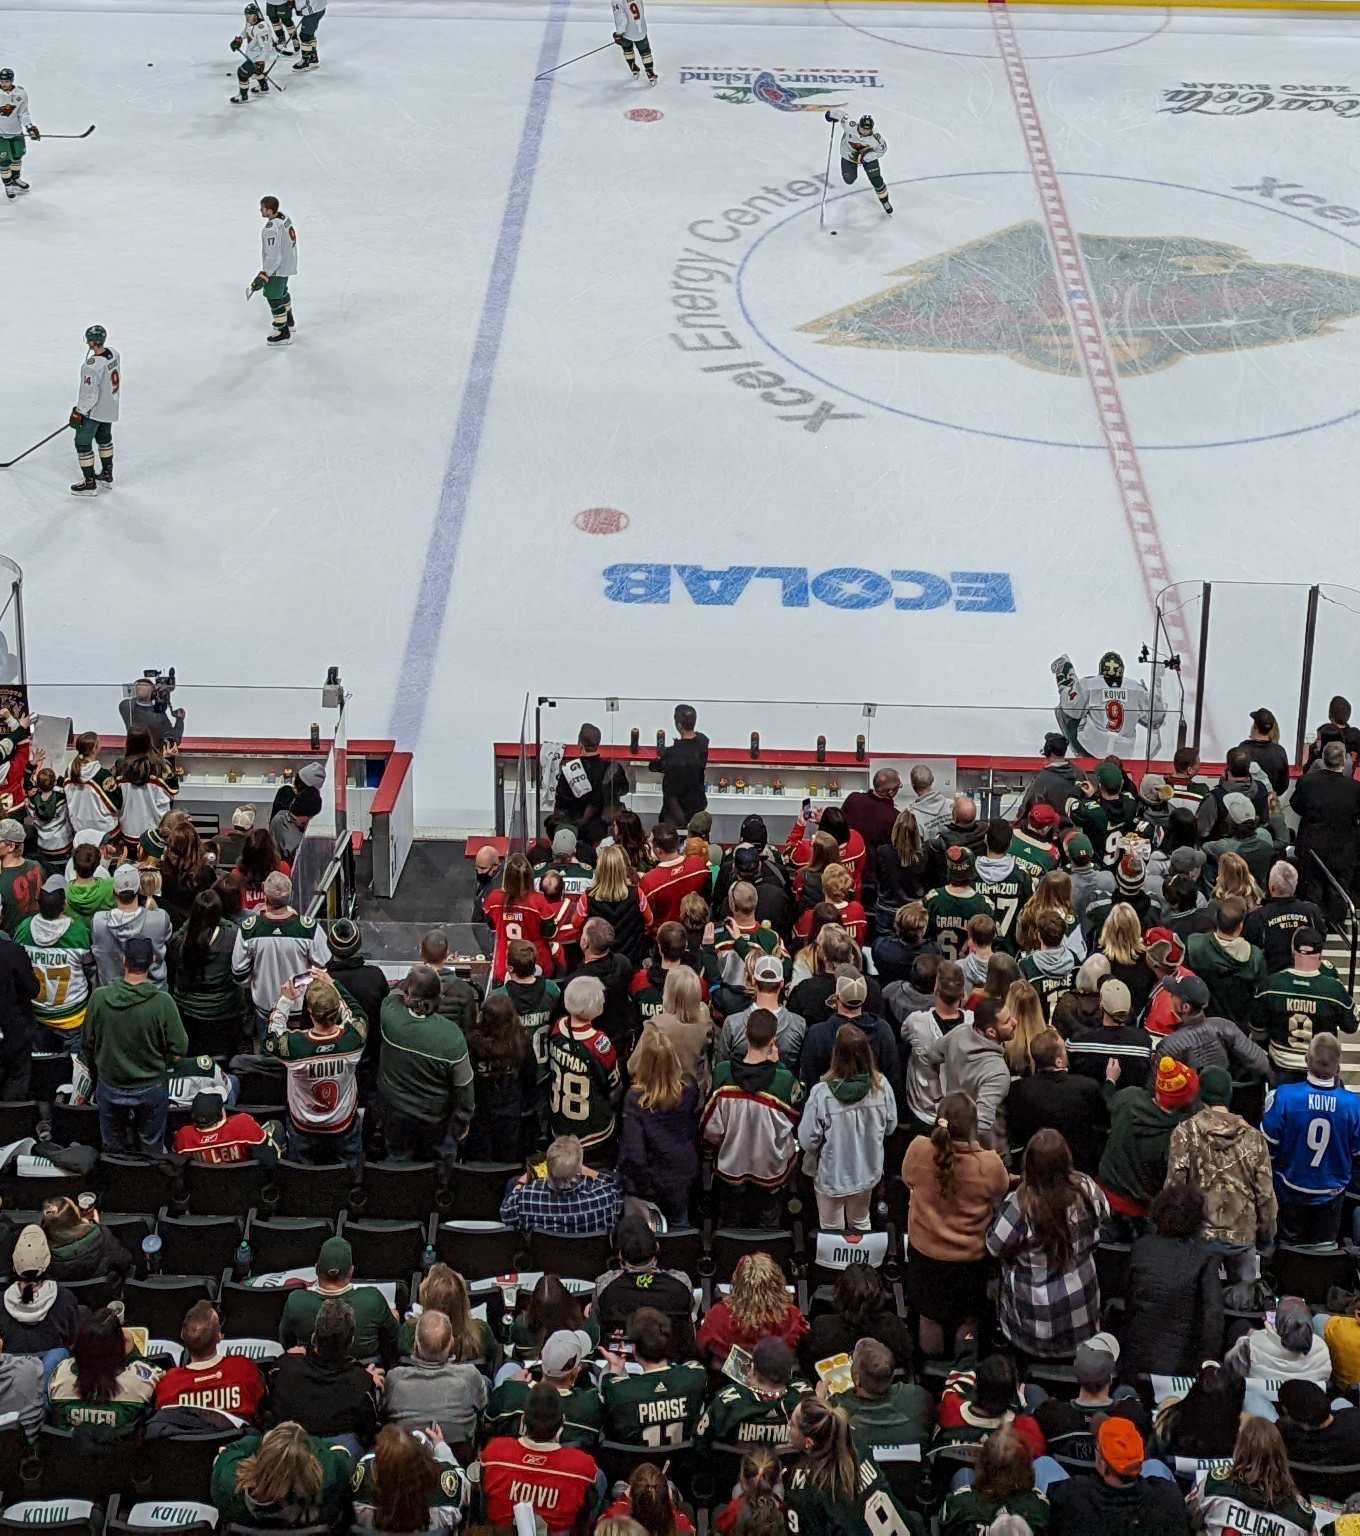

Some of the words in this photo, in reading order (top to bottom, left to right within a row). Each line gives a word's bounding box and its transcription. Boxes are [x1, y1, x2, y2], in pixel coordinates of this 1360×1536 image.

[679, 71, 751, 85] Island
[780, 72, 885, 89] Treasure
[1182, 81, 1274, 92] SUGAR
[1280, 83, 1352, 93] ZERO
[669, 247, 743, 353] Energy
[700, 360, 867, 434] Xcel
[602, 563, 1017, 614] ECOLAB
[1104, 689, 1126, 701] KOIVU
[1106, 701, 1125, 733] 9
[1286, 998, 1318, 1013] KOIVU
[309, 1061, 344, 1078] KOIVU
[549, 1074, 590, 1121] 38
[1308, 1093, 1337, 1114] KOIVU
[1307, 1118, 1332, 1158] 9
[834, 1247, 870, 1265] KOIVU
[640, 1396, 687, 1421] PARISE
[509, 1478, 560, 1513] KOIVU
[150, 1504, 198, 1527] KOIVU
[1226, 1504, 1286, 1535] FOLIGNO
